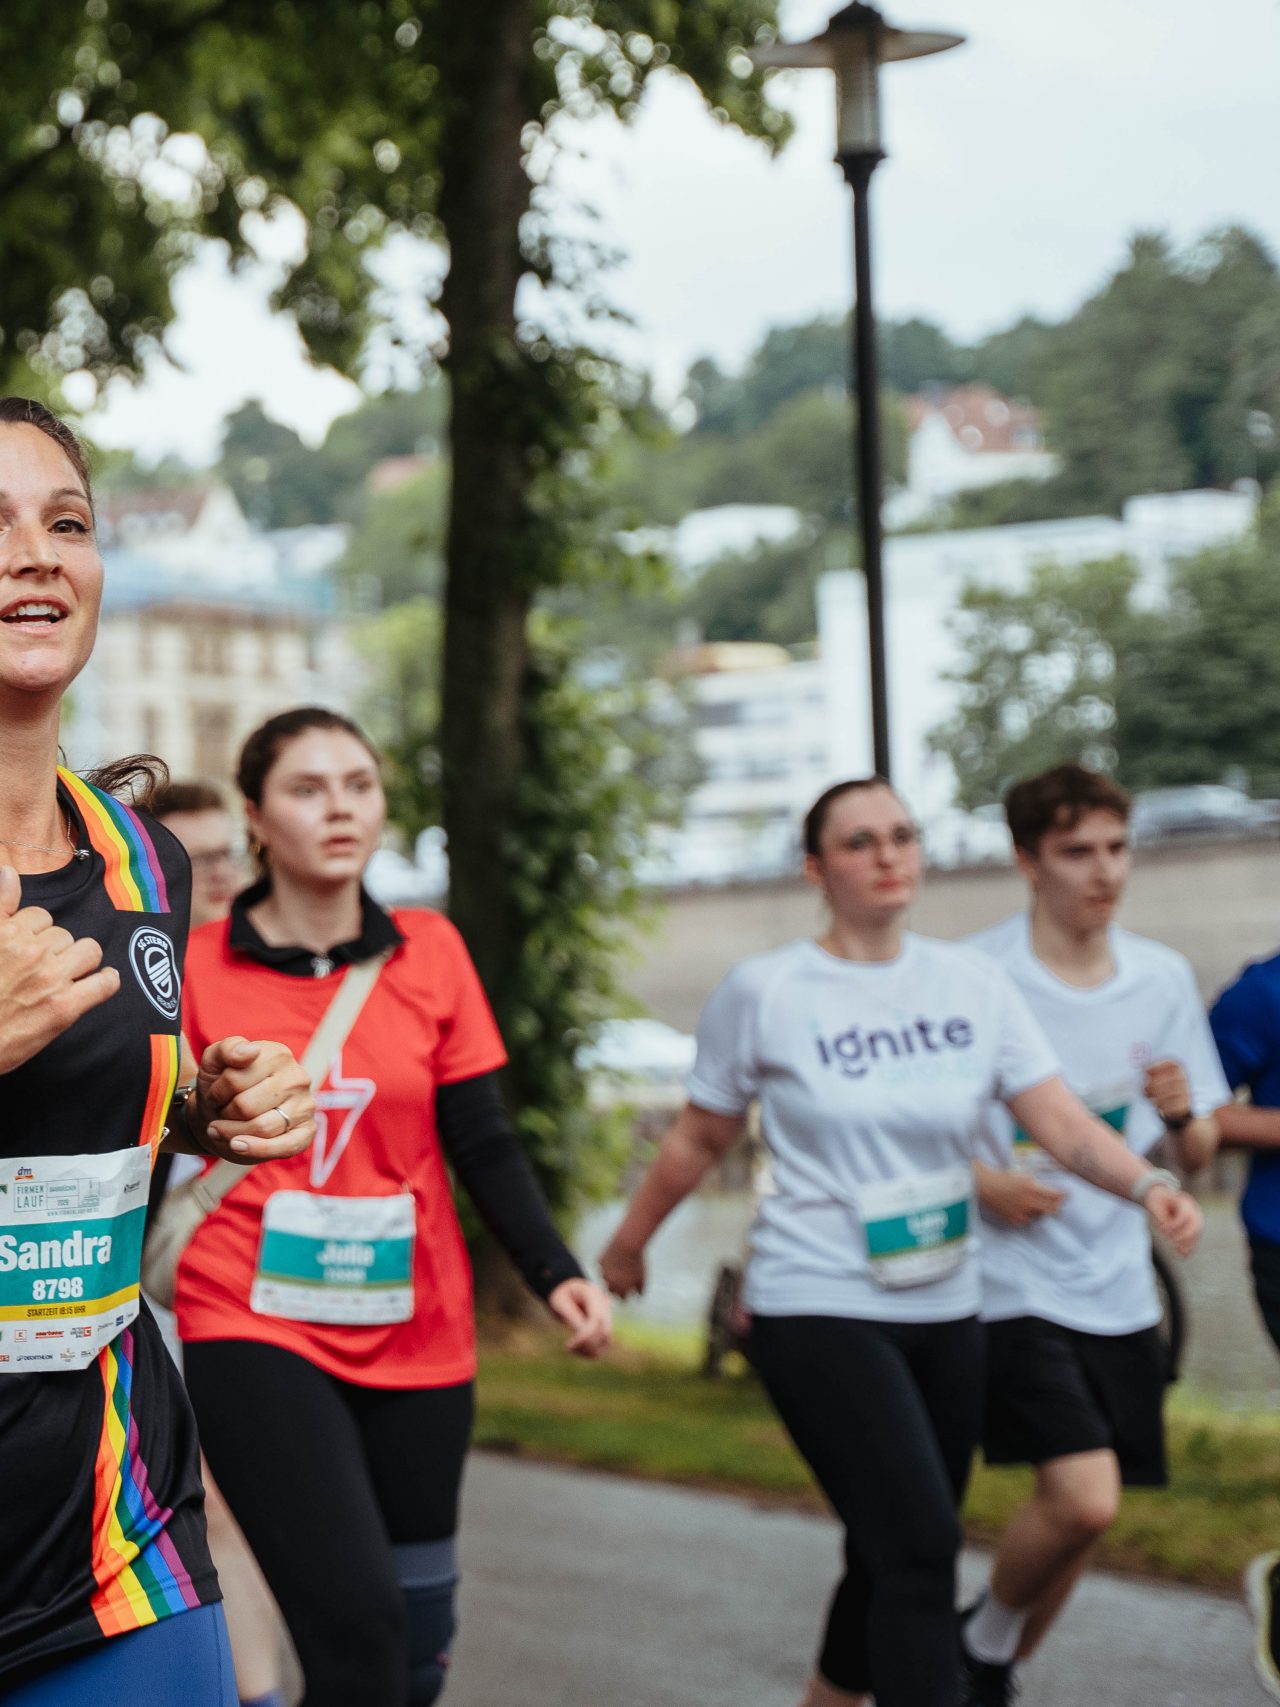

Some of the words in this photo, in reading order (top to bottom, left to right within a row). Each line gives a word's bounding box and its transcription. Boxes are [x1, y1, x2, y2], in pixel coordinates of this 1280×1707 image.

[136, 938, 147, 951] SG
[143, 935, 169, 951] STERN
[809, 1010, 976, 1077] ignite
[17, 1166, 33, 1176] dm
[16, 1184, 45, 1195] FIRMEN
[16, 1195, 45, 1209] LAUF
[31, 1276, 84, 1301] 8798
[26, 1307, 58, 1318] STARTZEIT
[59, 1306, 73, 1315] 18:15
[74, 1305, 86, 1314] UHR
